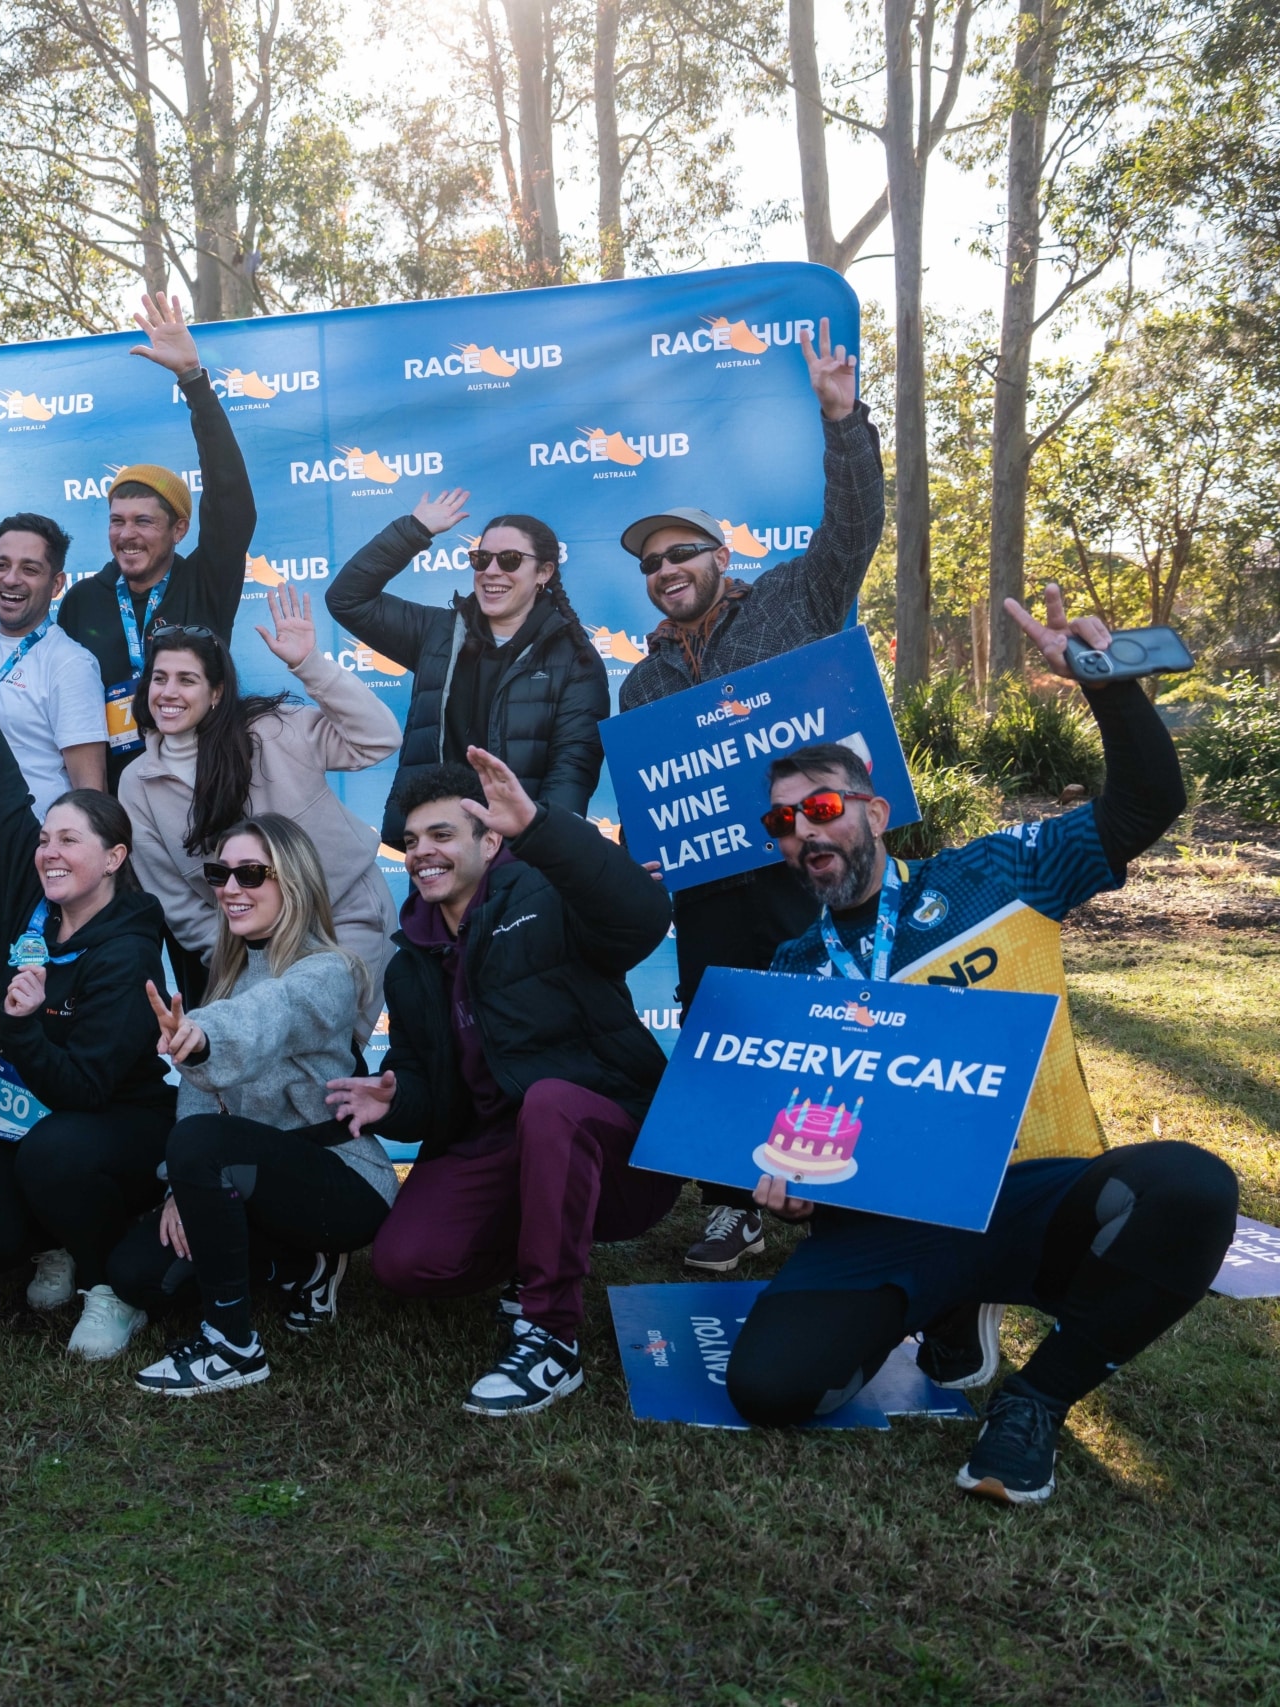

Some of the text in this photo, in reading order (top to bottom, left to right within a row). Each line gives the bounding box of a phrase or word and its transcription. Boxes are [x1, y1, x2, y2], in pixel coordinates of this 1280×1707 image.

[651, 320, 815, 357] RACE HUB
[404, 344, 562, 379] RACE HUB
[716, 358, 760, 369] AUSTRALIA
[263, 370, 320, 393] HUB
[467, 381, 510, 391] AUSTRALIA
[44, 393, 94, 415] HUB
[229, 402, 270, 411] AUSTRALIA
[8, 424, 46, 432] AUSTRALIA
[530, 432, 690, 466] RACE HUB
[290, 451, 444, 484] RACE HUB
[592, 470, 637, 479] AUSTRALIA
[63, 477, 114, 500] RAC
[351, 488, 393, 497] AUSTRALIA
[272, 557, 329, 581] HUB
[414, 548, 472, 573] RAC
[322, 649, 375, 672] ACE
[364, 680, 401, 689] USTRALIA
[696, 692, 771, 728] RACE HUB
[638, 707, 826, 793] WHINE NOW
[648, 785, 730, 832] WINE
[659, 822, 752, 872] LATER
[809, 1003, 907, 1028] RACE HUB
[693, 1032, 1006, 1097] I DESERVE CAKE
[690, 1316, 728, 1348] YOU
